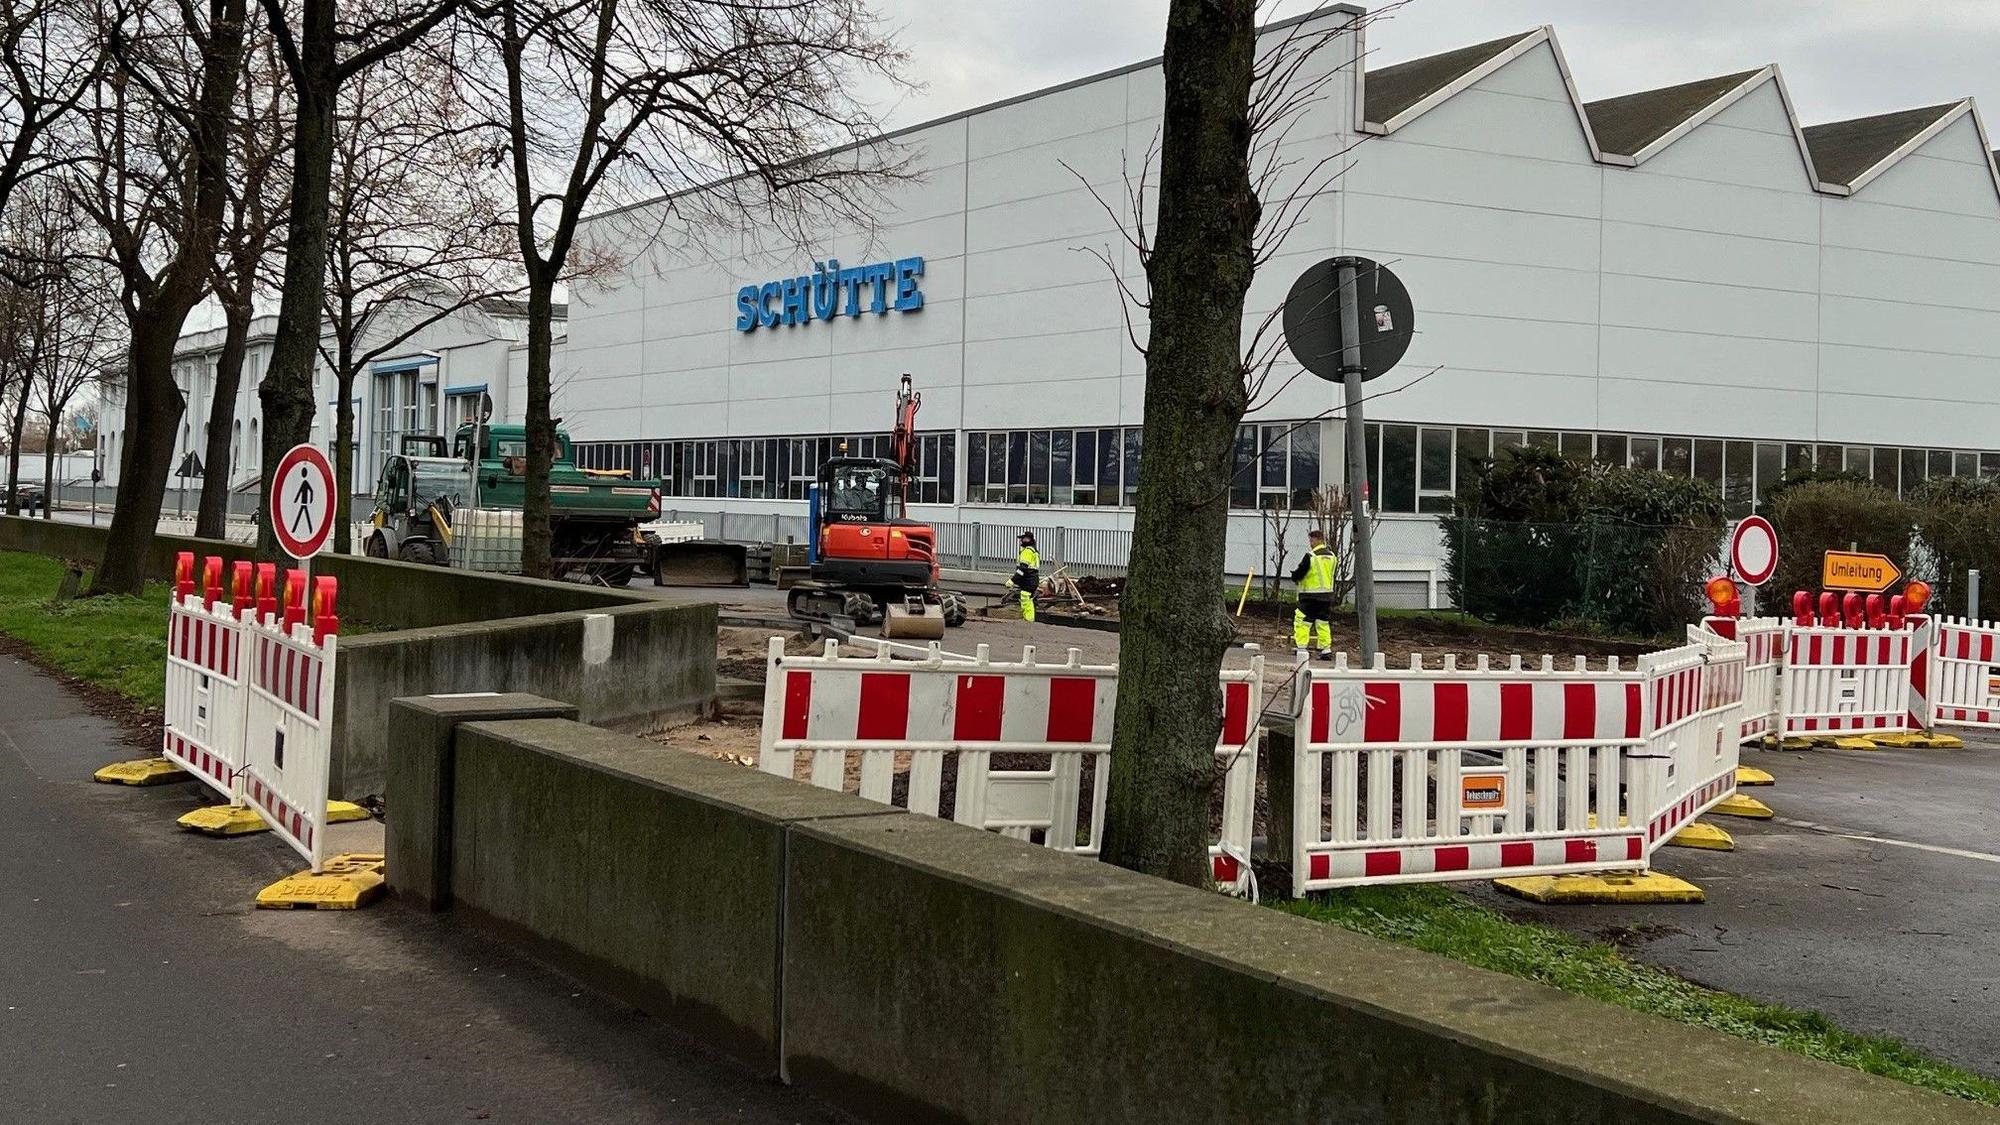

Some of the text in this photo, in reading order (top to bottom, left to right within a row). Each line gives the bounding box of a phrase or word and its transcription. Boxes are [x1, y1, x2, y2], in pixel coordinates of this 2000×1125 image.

[737, 256, 925, 331] SCHÜTTE
[841, 513, 868, 521] Kubota
[1831, 561, 1882, 582] Umleitung
